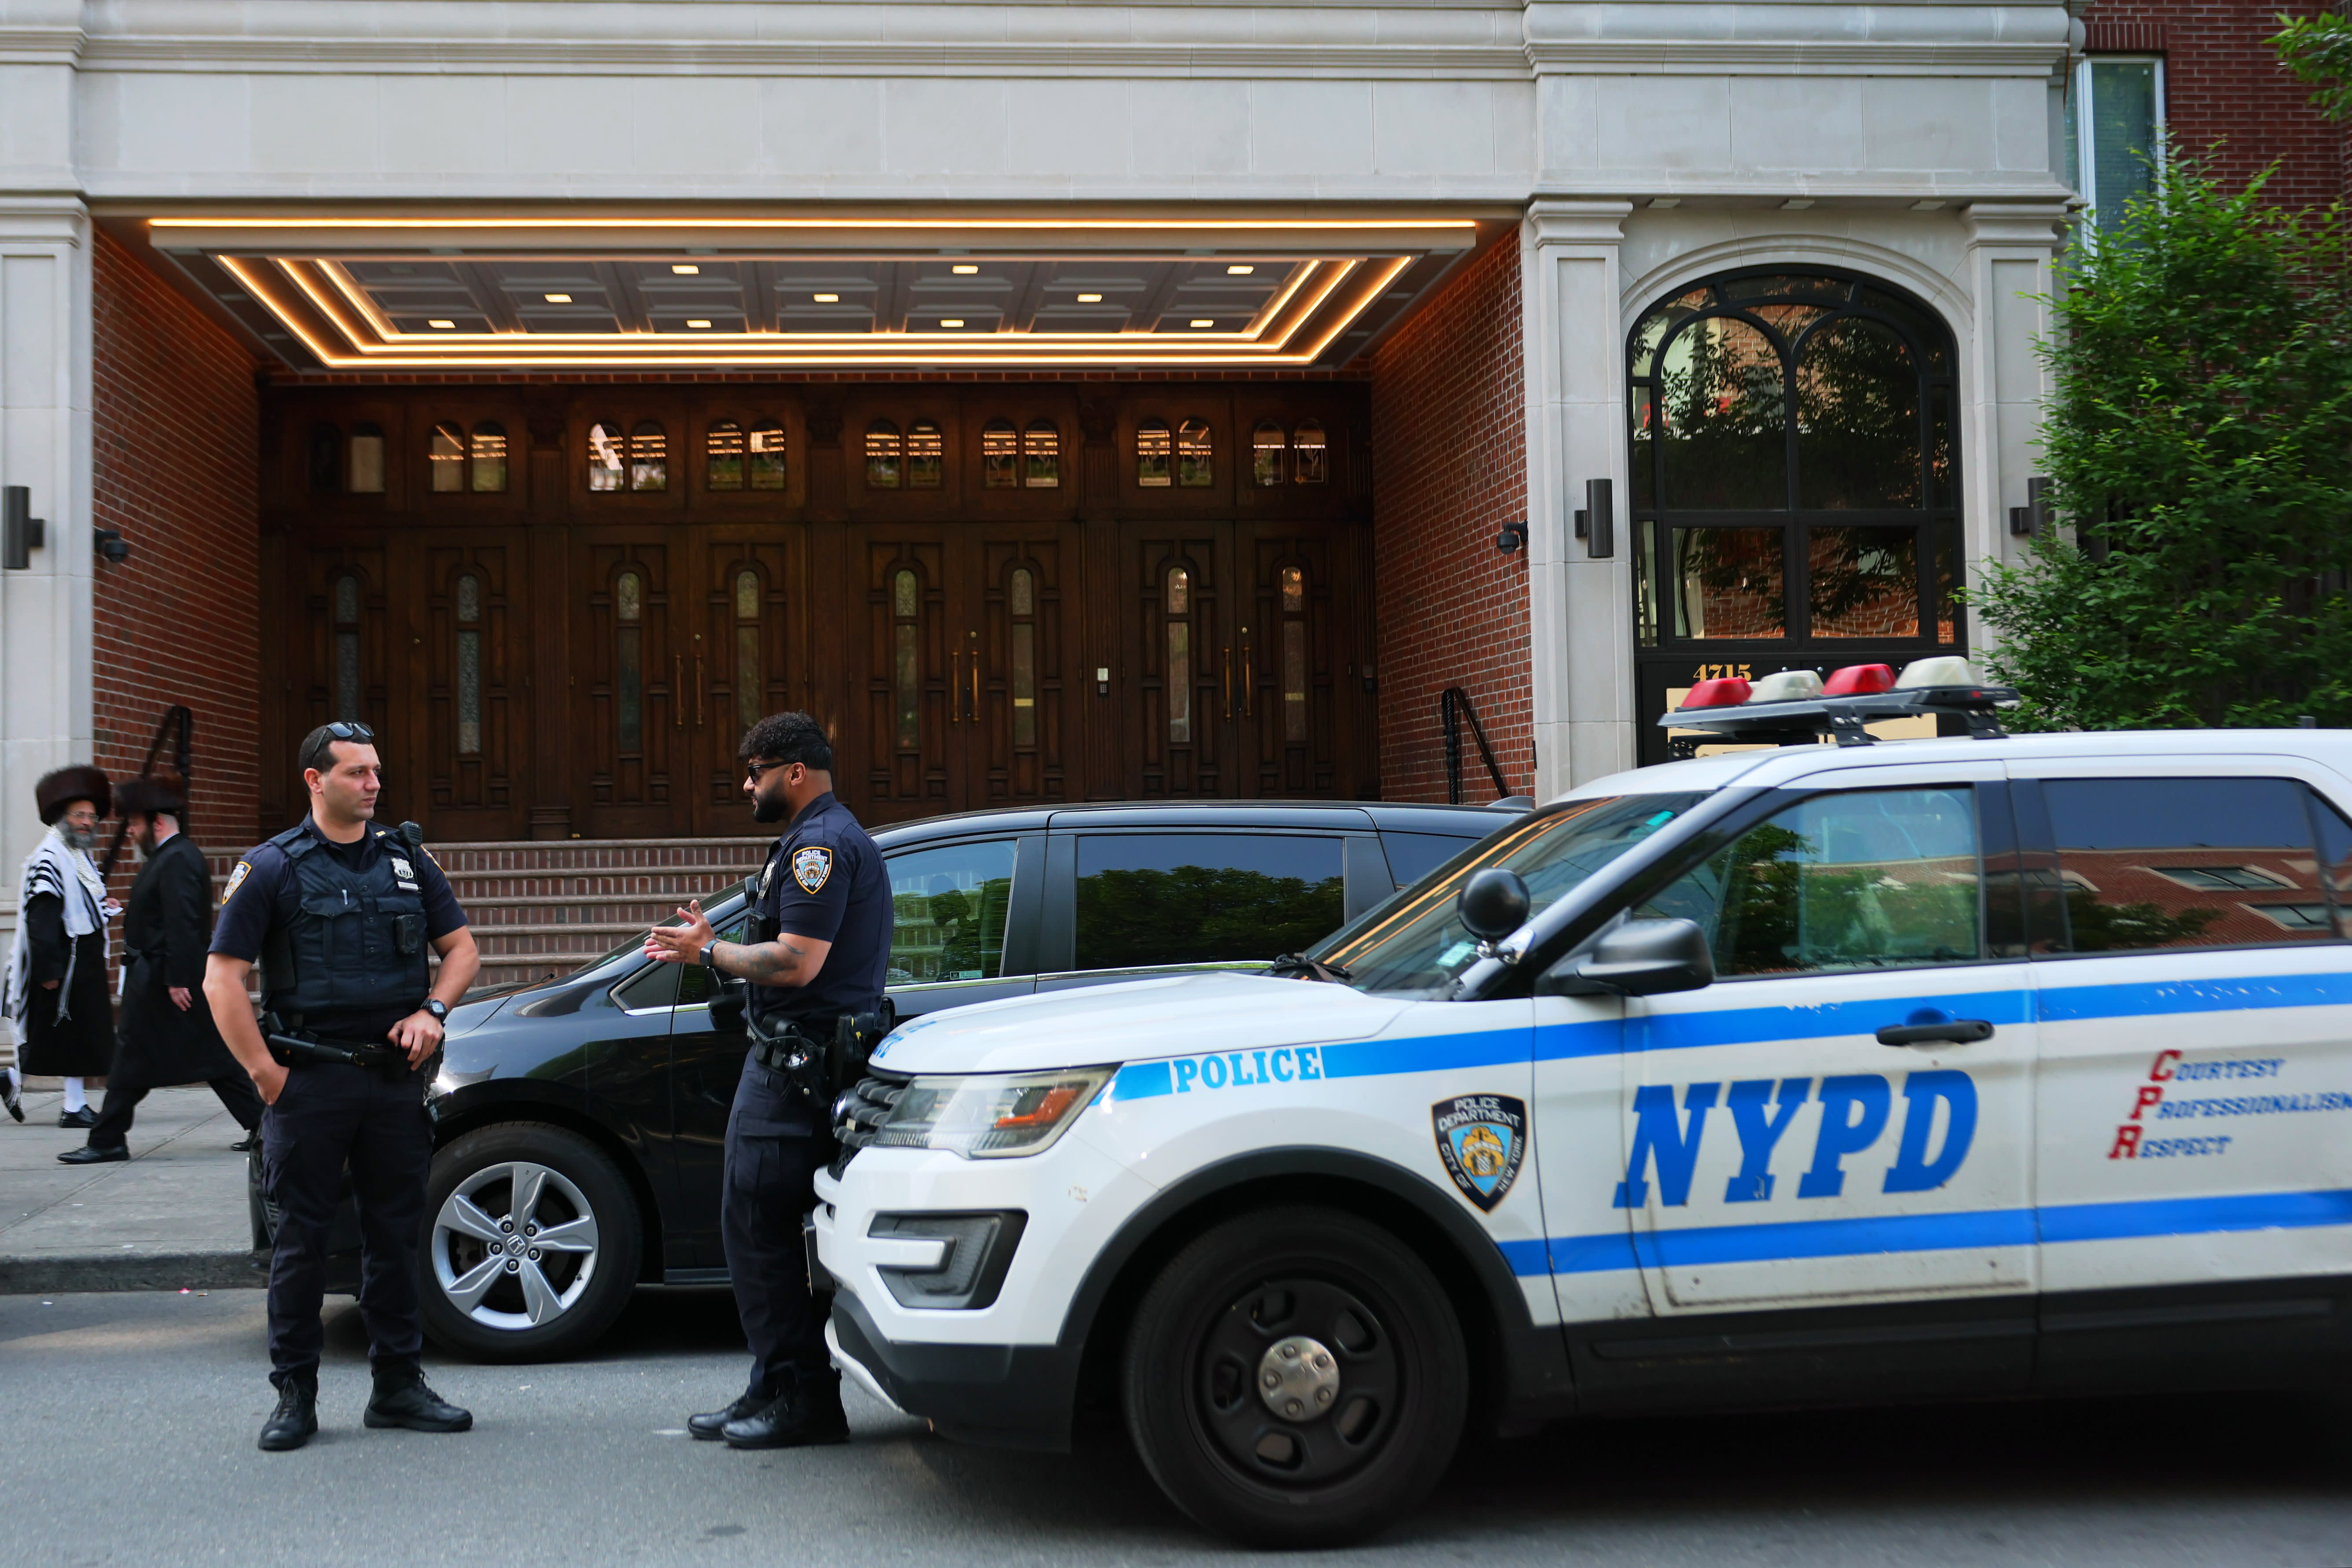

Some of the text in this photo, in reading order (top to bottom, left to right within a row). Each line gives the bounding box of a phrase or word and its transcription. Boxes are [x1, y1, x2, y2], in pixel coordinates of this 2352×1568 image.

[1693, 664, 1752, 682] 4715
[796, 855, 828, 864] DEPARTMENT
[815, 877, 823, 888] NEW
[1173, 1047, 1321, 1094] POLICE
[2148, 1049, 2286, 1082] COURTESY
[1438, 1108, 1521, 1132] DEPARTMENT
[1454, 1096, 1501, 1112] POLICE
[1612, 1069, 1978, 1208] NYPD
[2107, 1124, 2233, 1160] RESPECT
[1440, 1142, 1472, 1188] CITY OF
[1498, 1135, 1523, 1193] NEW YORK
